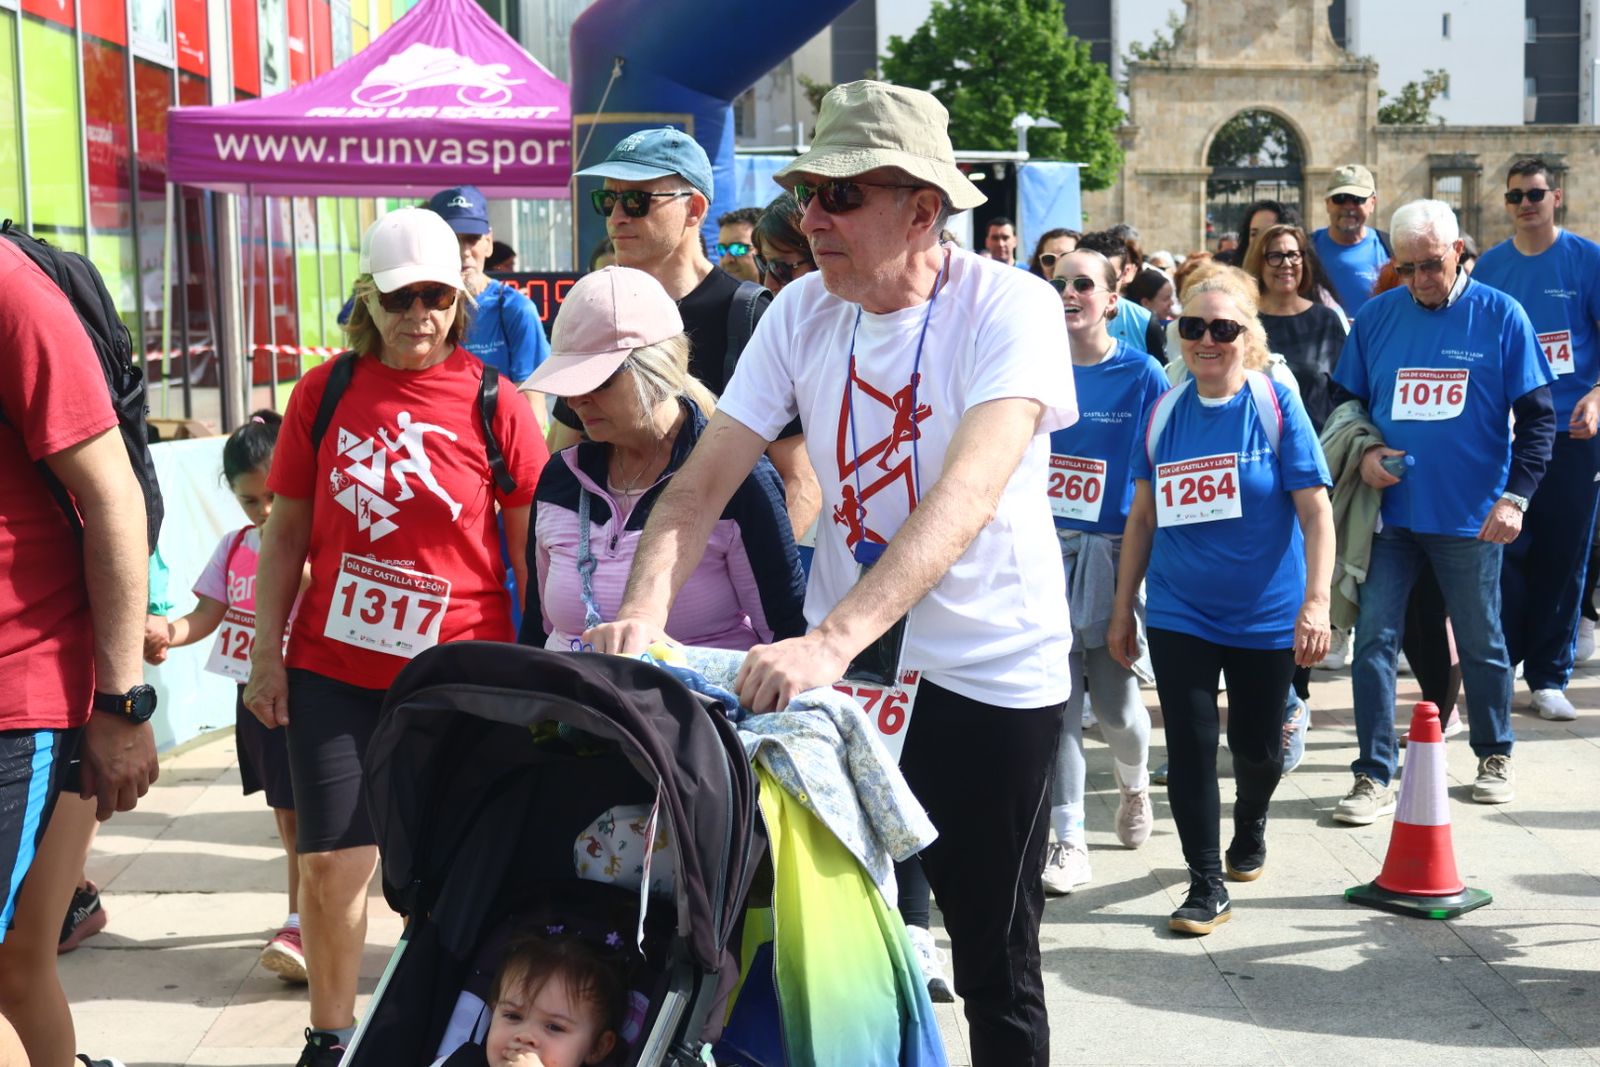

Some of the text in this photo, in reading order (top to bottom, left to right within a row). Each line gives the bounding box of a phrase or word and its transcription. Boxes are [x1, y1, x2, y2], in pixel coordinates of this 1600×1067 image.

[213, 132, 571, 175] www.runvaspor
[1544, 343, 1570, 364] 14
[1399, 382, 1463, 406] 1016
[1054, 458, 1081, 469] CASTILLA
[1086, 462, 1103, 471] LEÓN
[1160, 466, 1171, 475] DÍA
[1180, 462, 1209, 472] CASTILLA
[1215, 458, 1233, 467] LEÓN
[1047, 471, 1101, 504] 260
[1160, 472, 1237, 508] 1264
[347, 560, 446, 593] DÍA DE CASTILLA Y LEÓN
[340, 580, 443, 637] 1317
[220, 627, 256, 661] 12
[832, 684, 909, 736] 76
